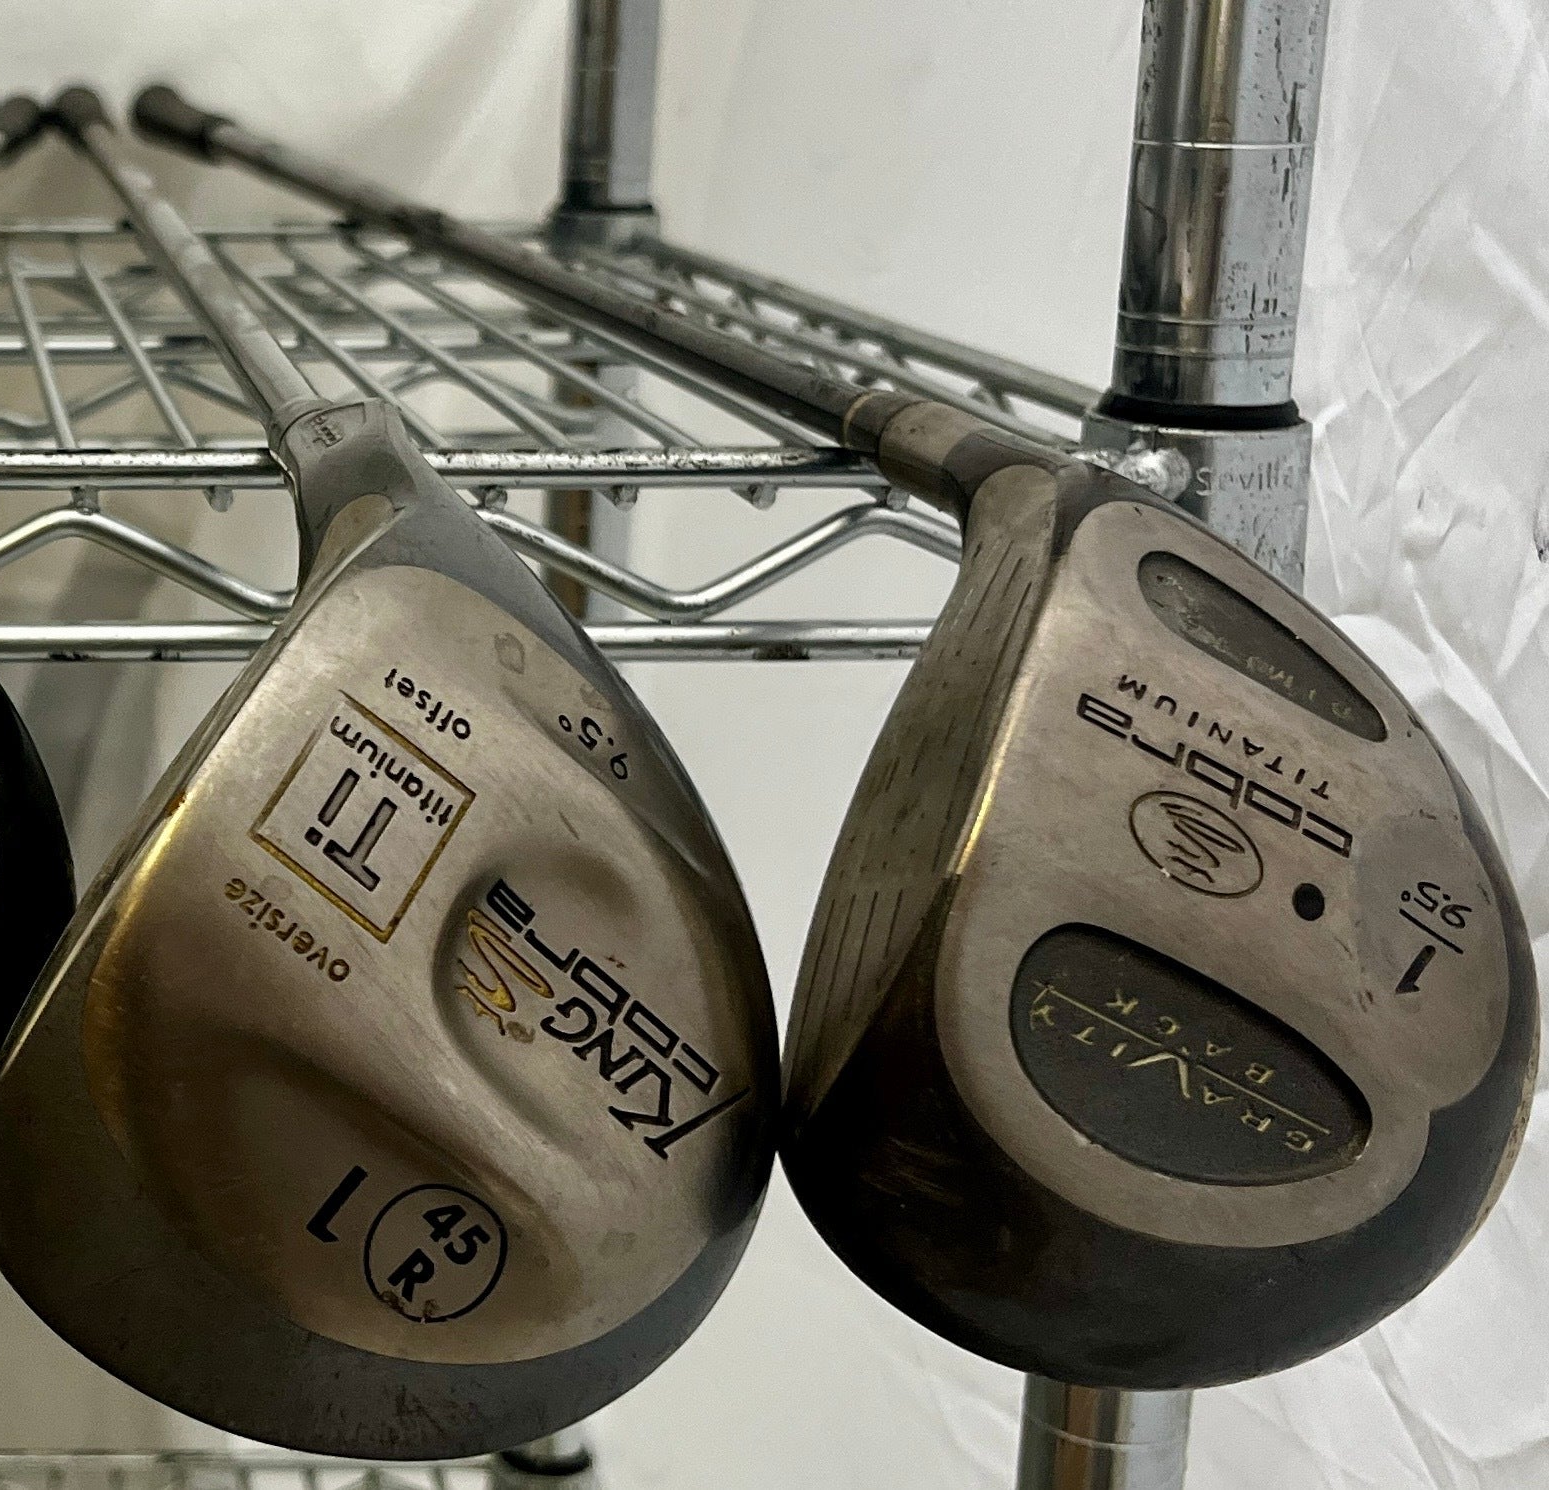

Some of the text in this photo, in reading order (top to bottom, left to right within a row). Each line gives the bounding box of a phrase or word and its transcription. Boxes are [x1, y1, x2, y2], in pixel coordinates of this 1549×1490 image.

[382, 666, 471, 741] offset
[556, 711, 628, 779] 9.5°
[1113, 673, 1330, 799] TITANIUM
[328, 715, 452, 830] titanium
[1076, 691, 1352, 858] cobra
[303, 768, 396, 890] Ti
[222, 877, 350, 986] oversize
[486, 877, 719, 1092] cobra
[1395, 946, 1440, 993] 1
[539, 1002, 749, 1160] KING
[1030, 1002, 1315, 1152] GRAVITY
[1104, 988, 1273, 1084] BACK
[306, 1165, 367, 1242] 1
[422, 1204, 490, 1265] 45
[387, 1248, 434, 1302] R
